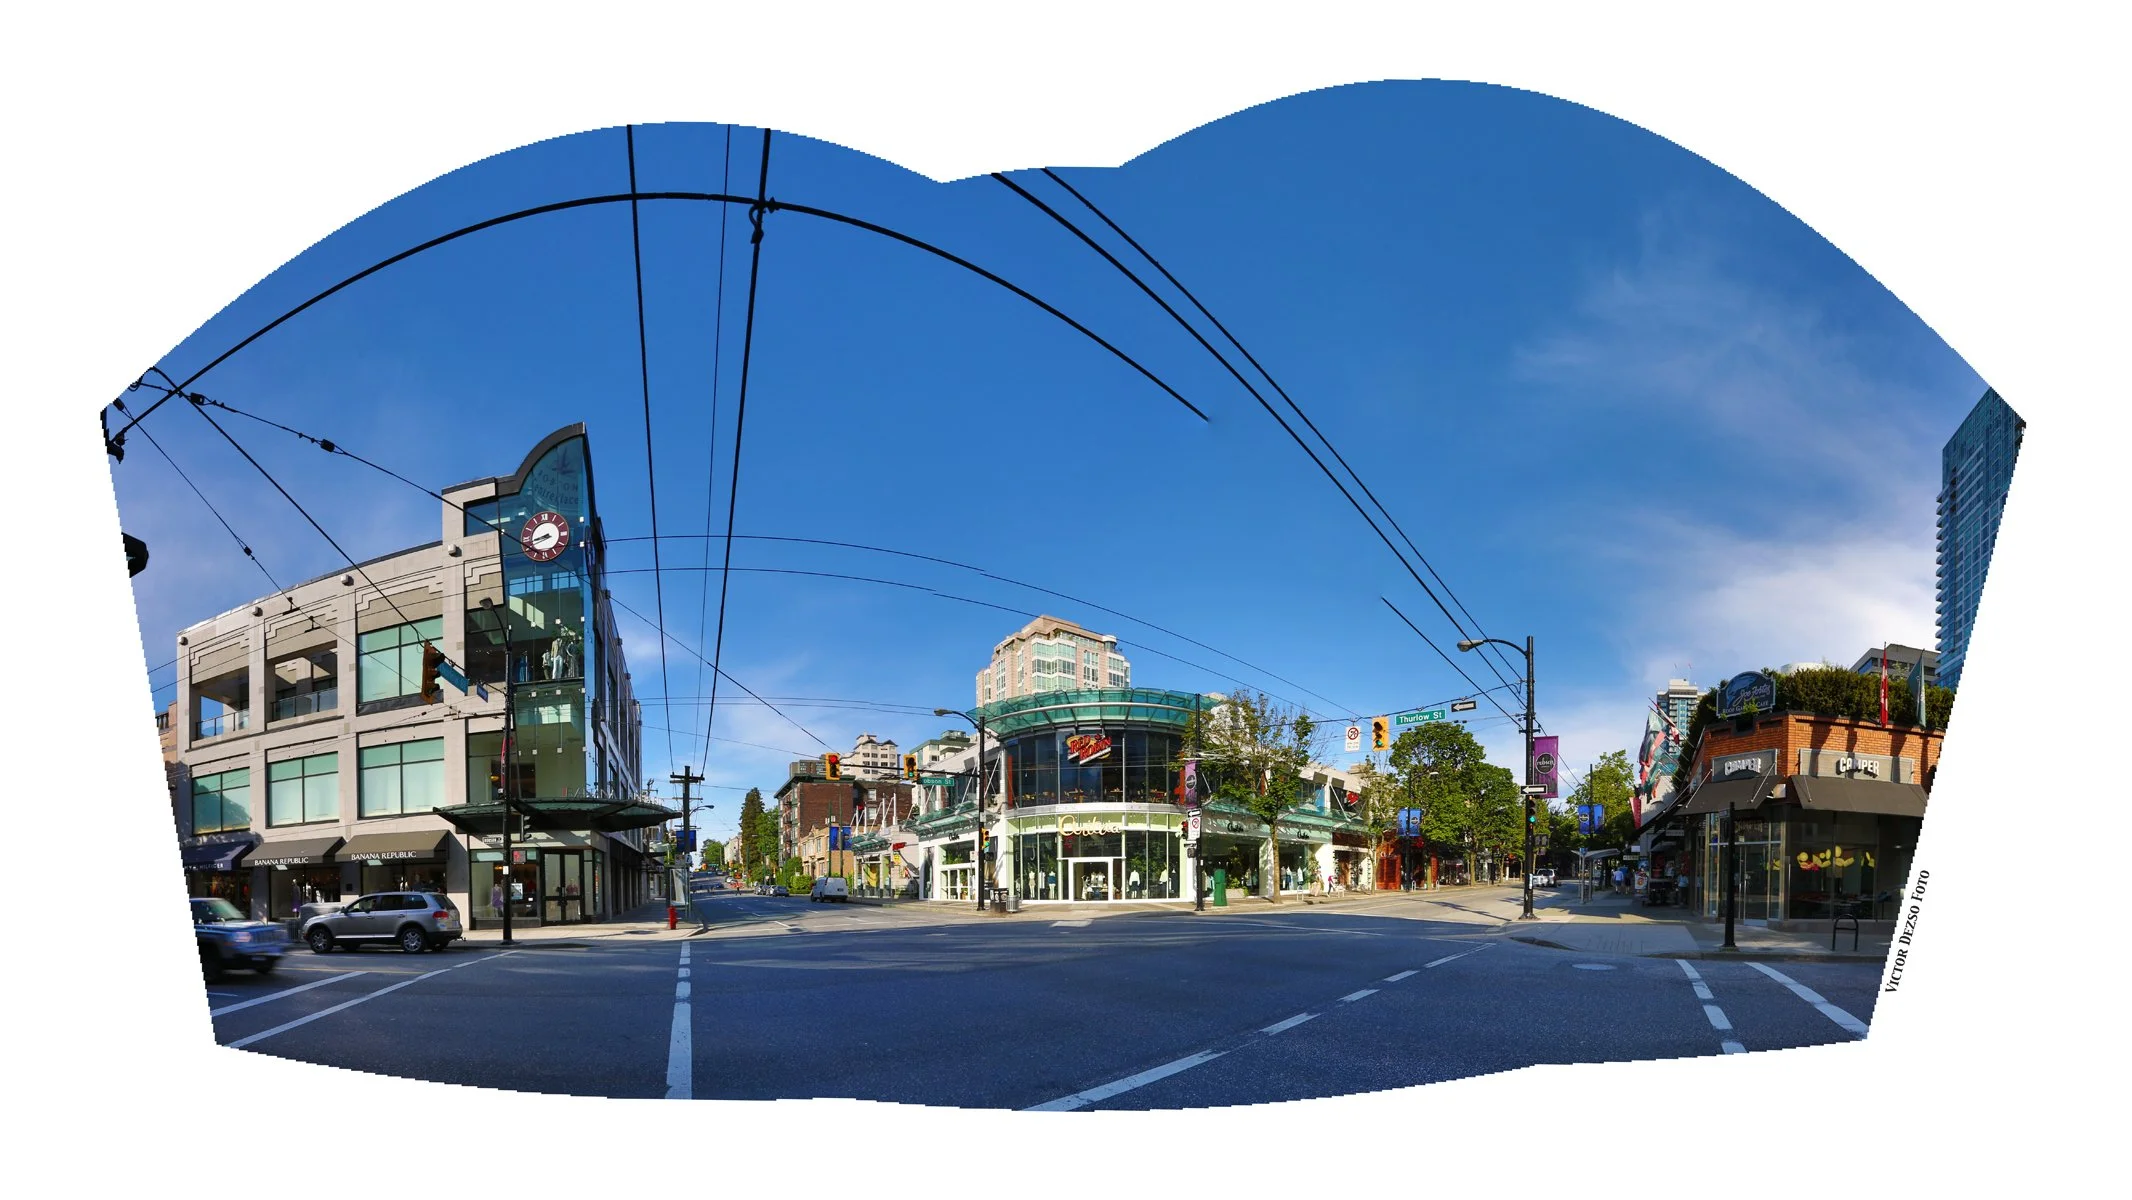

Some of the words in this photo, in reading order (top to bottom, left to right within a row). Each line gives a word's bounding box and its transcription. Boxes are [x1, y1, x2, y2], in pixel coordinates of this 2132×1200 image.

[1400, 714, 1429, 723] Thurlow
[1434, 711, 1442, 719] St
[1070, 734, 1091, 754] RED
[1839, 757, 1880, 777] CAMPER
[254, 858, 279, 866] BANANA
[279, 856, 309, 865] REPUBLIC
[351, 852, 380, 861] BANANA
[381, 850, 417, 860] REPUBLIC
